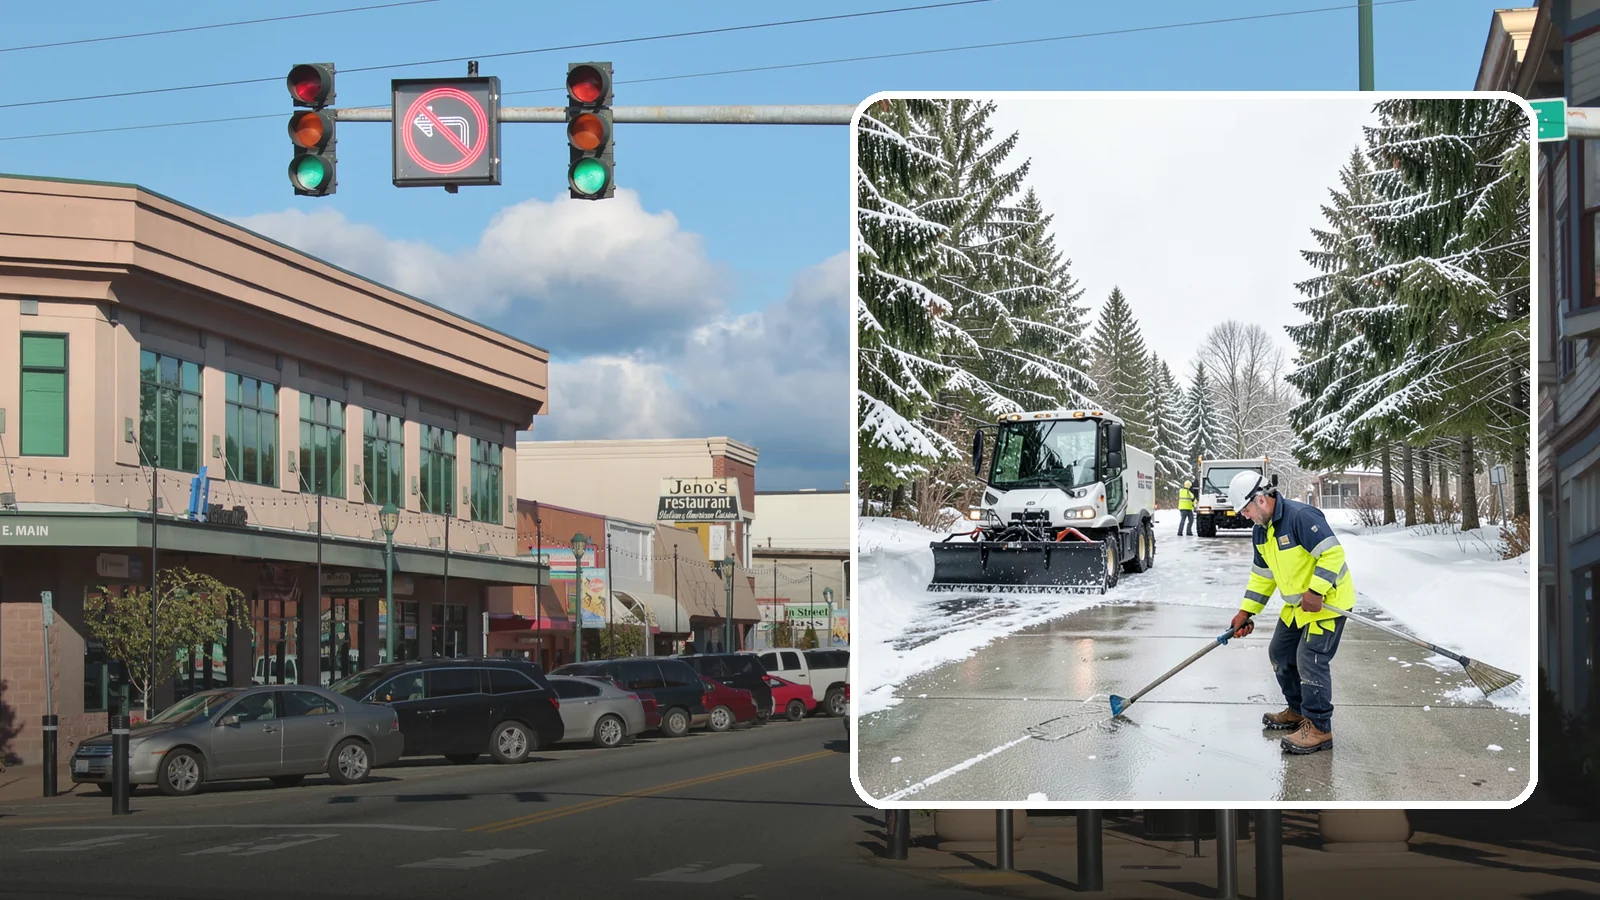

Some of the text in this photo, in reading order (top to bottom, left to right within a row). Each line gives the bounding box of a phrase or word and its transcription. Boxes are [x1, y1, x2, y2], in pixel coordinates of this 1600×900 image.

[669, 480, 728, 495] Jeno's
[665, 496, 731, 509] restaurant
[658, 509, 682, 519] Italian
[686, 509, 715, 519] American
[715, 509, 738, 519] Cuisine
[2, 525, 49, 536] E. MAIN
[785, 607, 795, 617] in
[797, 607, 828, 617] Street
[790, 619, 824, 627] lass
